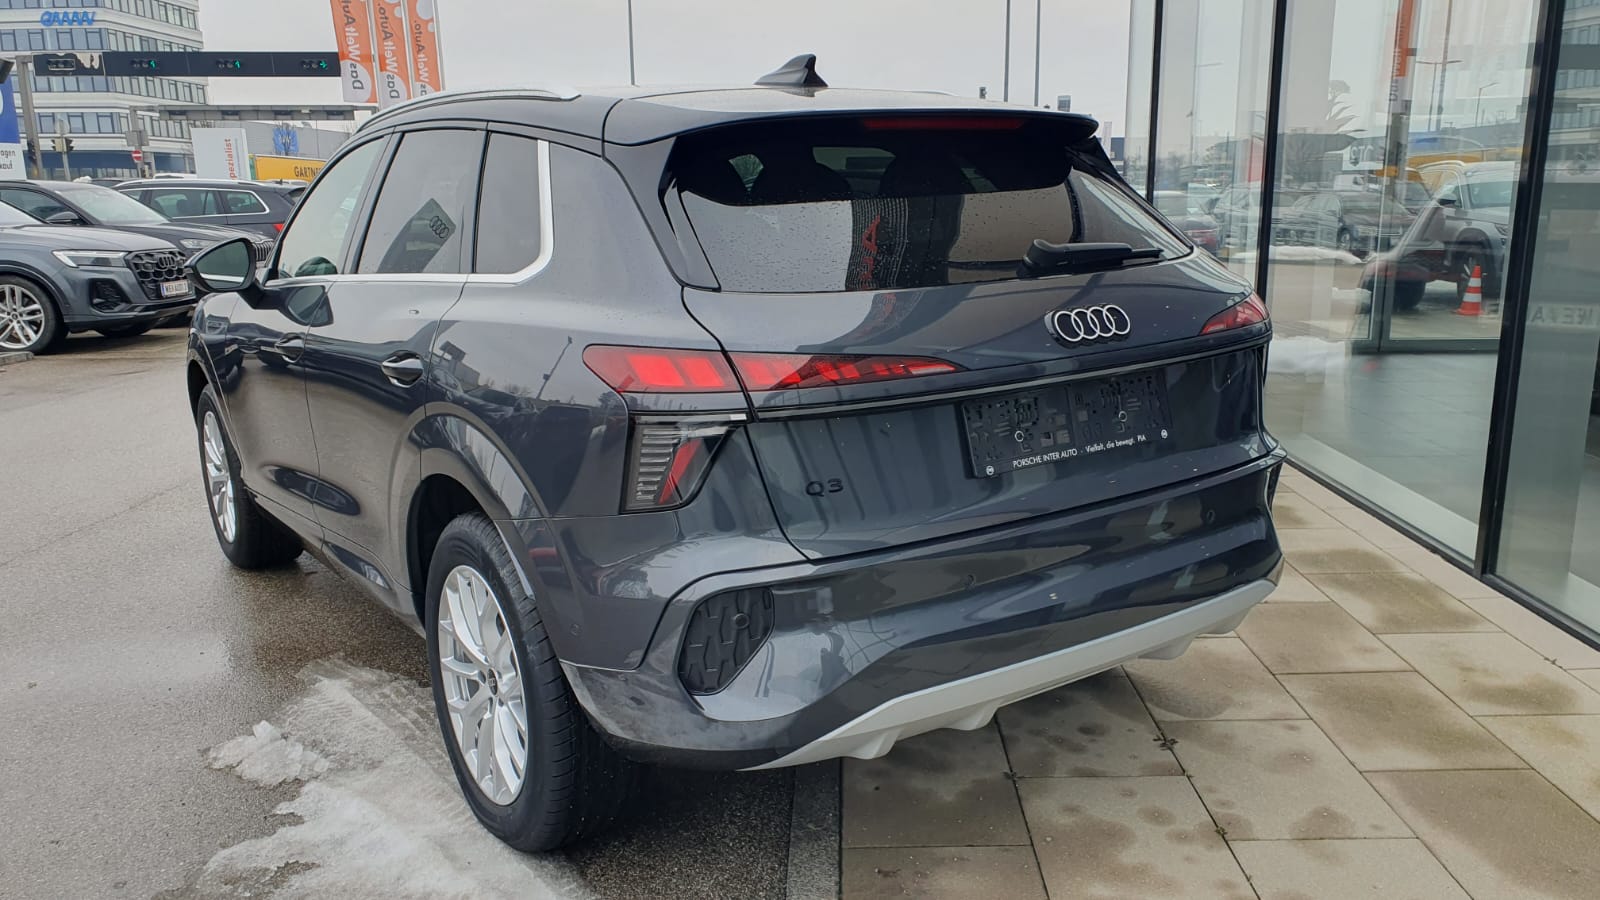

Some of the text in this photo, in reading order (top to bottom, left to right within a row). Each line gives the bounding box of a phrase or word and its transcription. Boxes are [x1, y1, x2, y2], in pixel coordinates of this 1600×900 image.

[224, 138, 238, 179] pezialist
[1012, 455, 1042, 468] PORSCHE
[1043, 451, 1060, 462] INTER
[1061, 448, 1078, 459] AUTO
[1085, 443, 1106, 453] Vielfalt,
[1106, 440, 1115, 449] die
[1137, 434, 1147, 443] PIA
[805, 478, 845, 497] Q3
